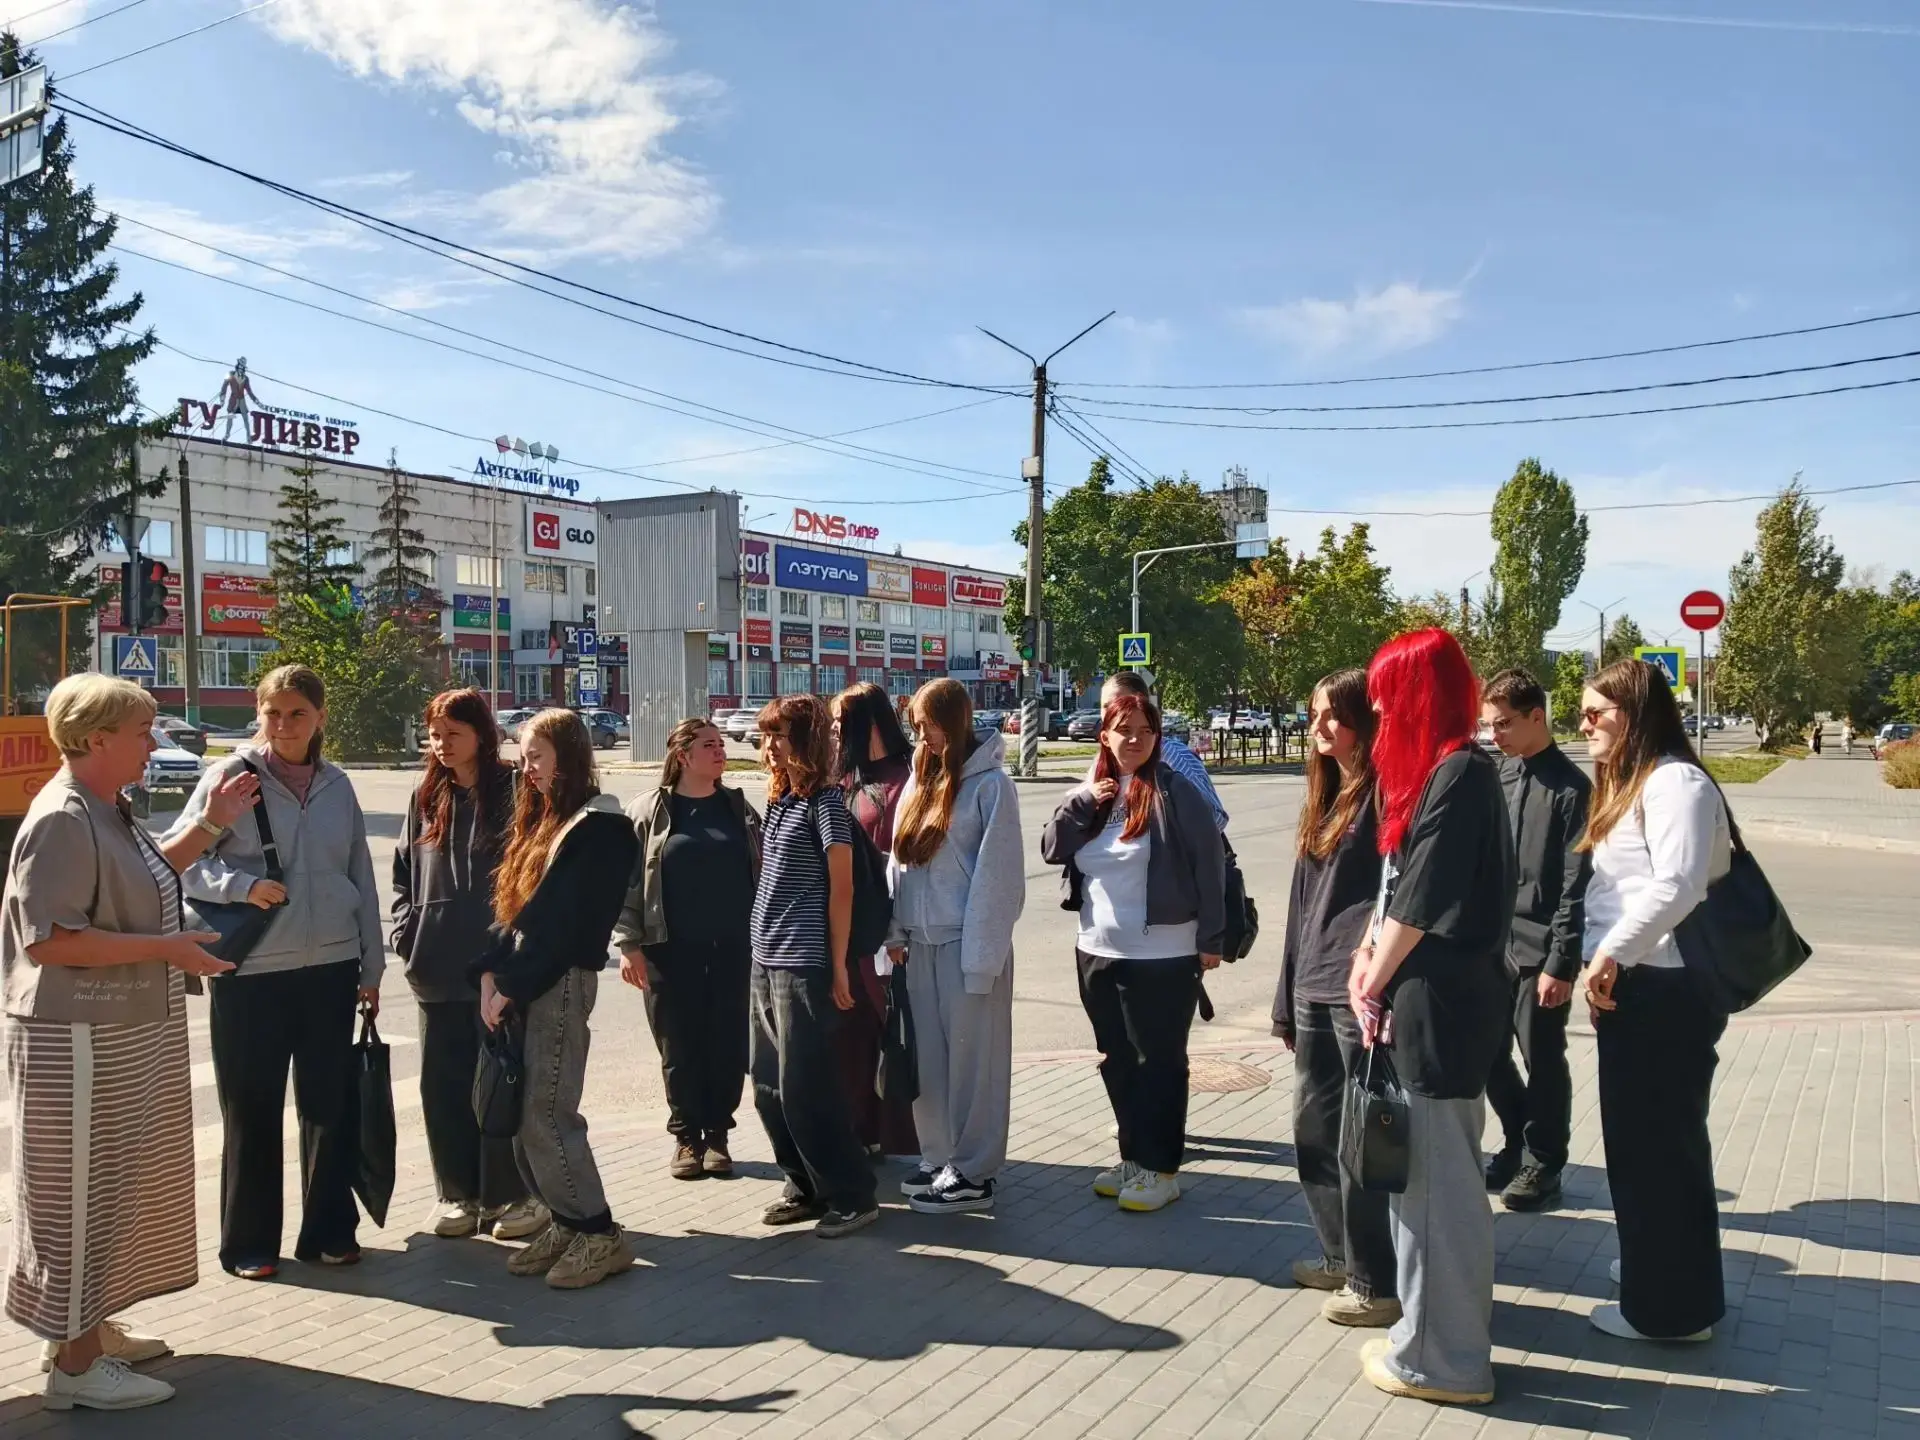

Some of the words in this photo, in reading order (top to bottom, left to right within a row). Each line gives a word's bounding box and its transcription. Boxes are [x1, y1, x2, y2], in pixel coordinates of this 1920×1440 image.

[474, 456, 544, 486] Детский
[549, 474, 580, 496] мир
[536, 520, 559, 541] GJ
[794, 507, 847, 539] DNS
[565, 527, 595, 545] GLO
[914, 580, 947, 593] SUNLIGHT
[583, 632, 594, 652] P
